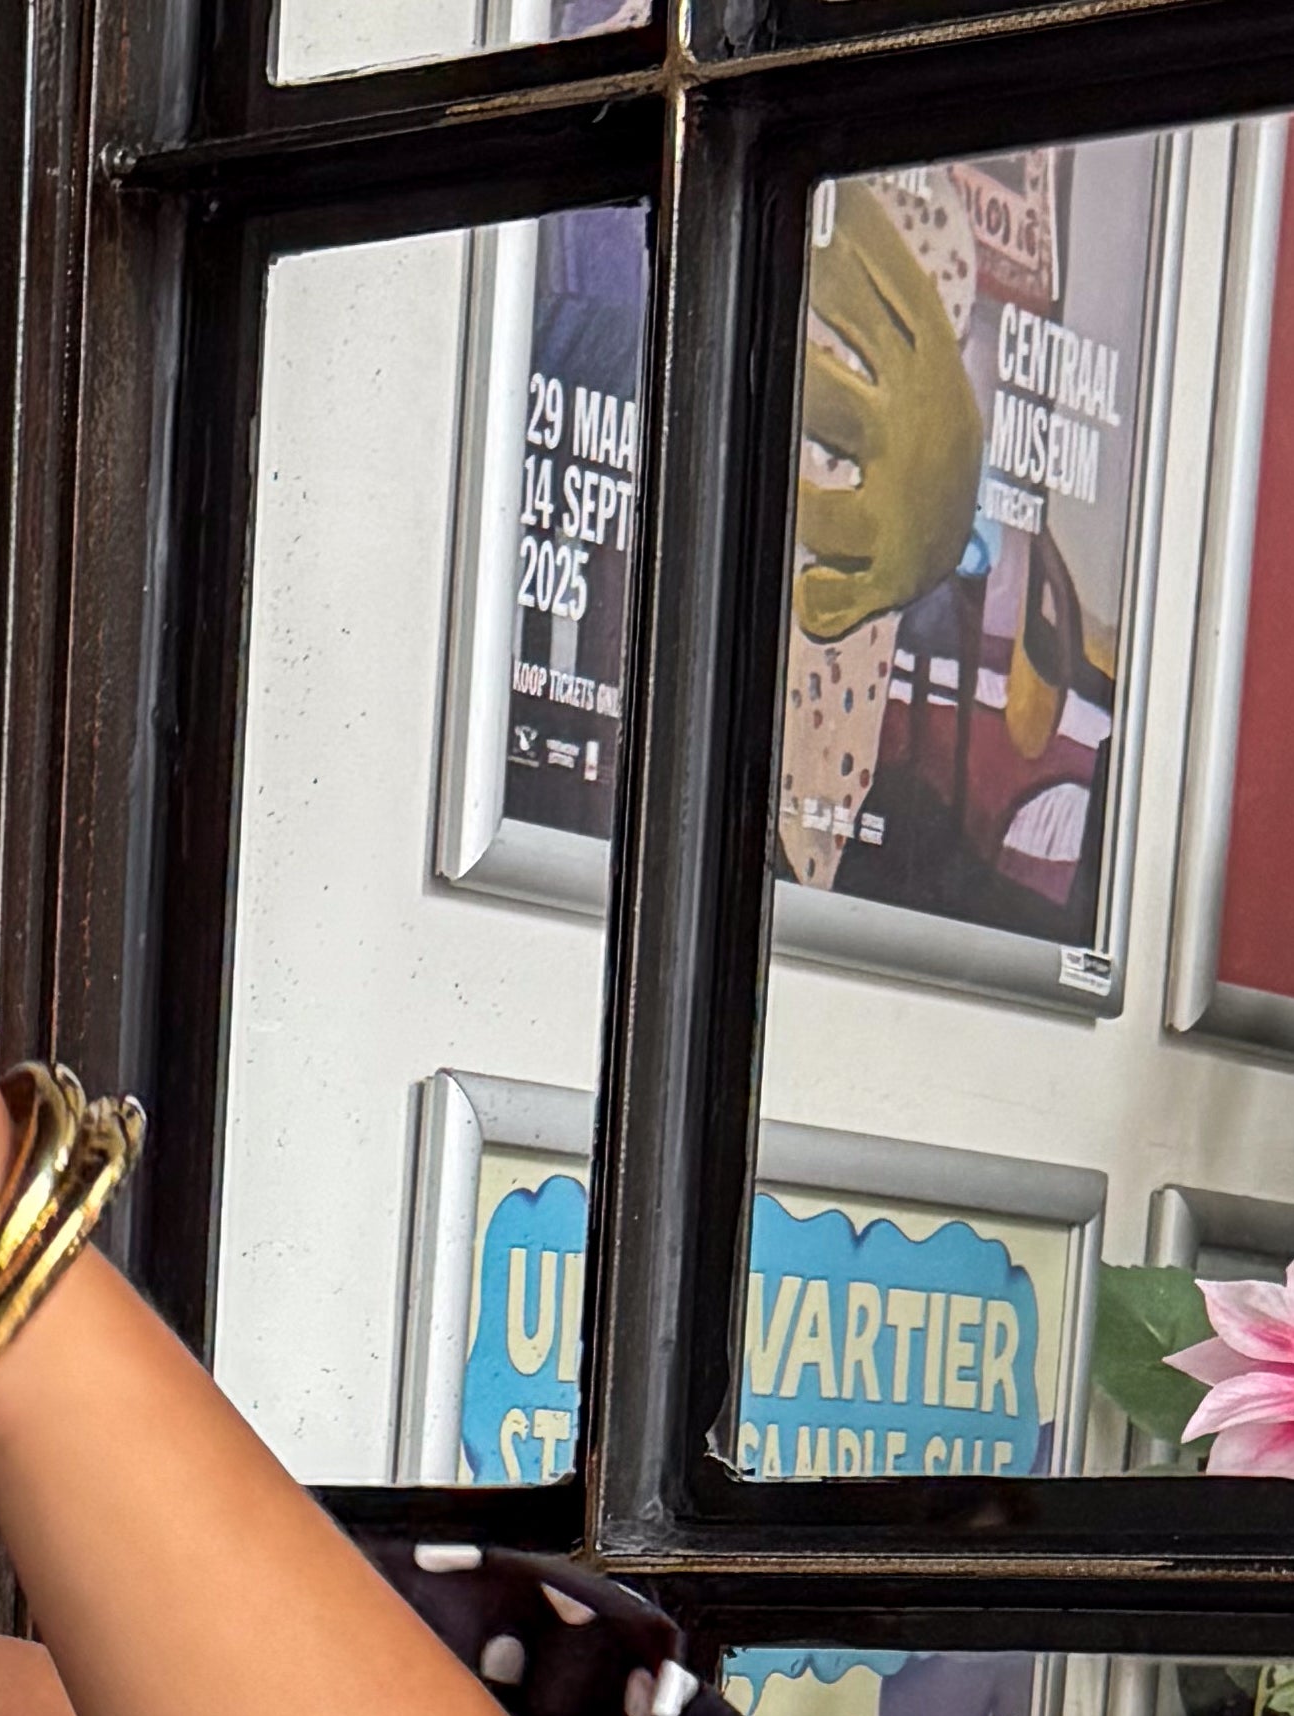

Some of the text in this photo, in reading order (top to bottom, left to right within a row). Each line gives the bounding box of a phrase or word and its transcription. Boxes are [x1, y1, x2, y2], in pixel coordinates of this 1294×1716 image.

[527, 372, 563, 449] 29
[998, 303, 1121, 427] CENTRAAL
[990, 390, 1100, 504] MUSEUM
[520, 454, 633, 551] 14 SEPT
[517, 535, 590, 621] 2025
[513, 660, 548, 697] KOOP
[549, 669, 596, 711] TICKETS
